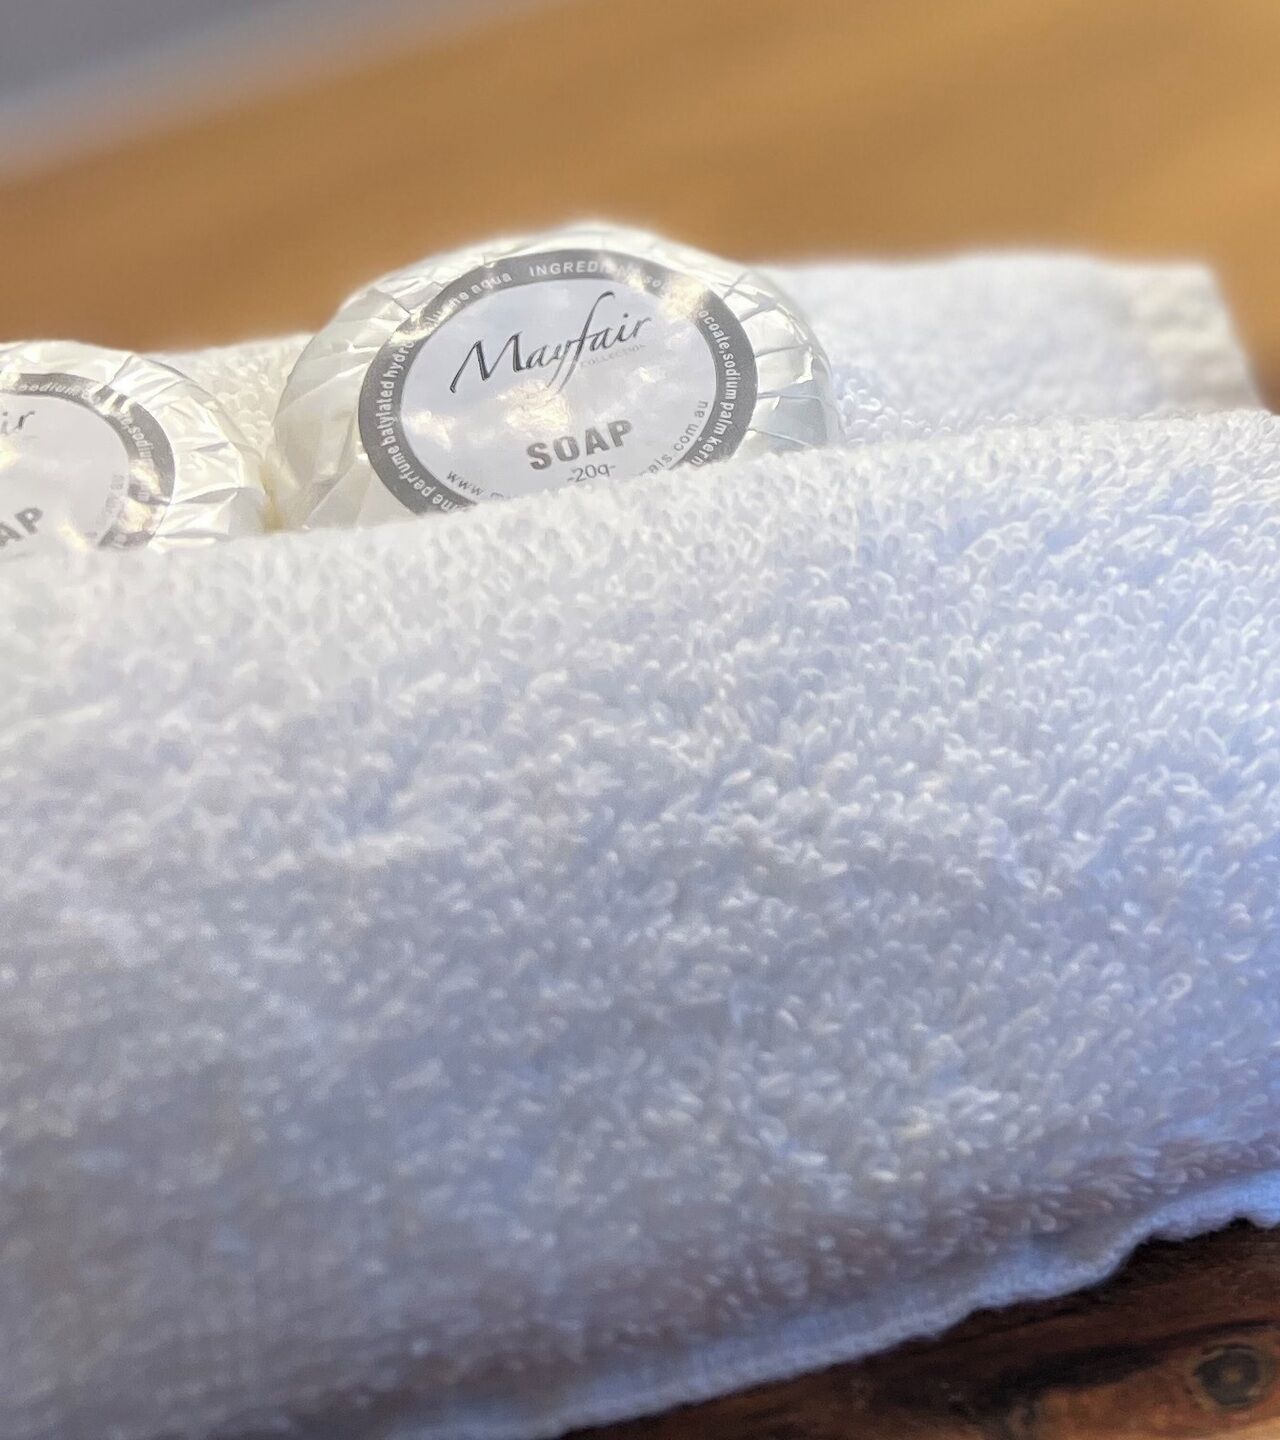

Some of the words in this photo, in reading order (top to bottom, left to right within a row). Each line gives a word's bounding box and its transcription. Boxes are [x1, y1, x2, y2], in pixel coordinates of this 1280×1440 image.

[450, 291, 651, 394] Mayfair
[387, 445, 437, 504] perfume
[471, 270, 513, 295] aqua
[713, 399, 739, 436] palm
[526, 419, 633, 471] SOAP
